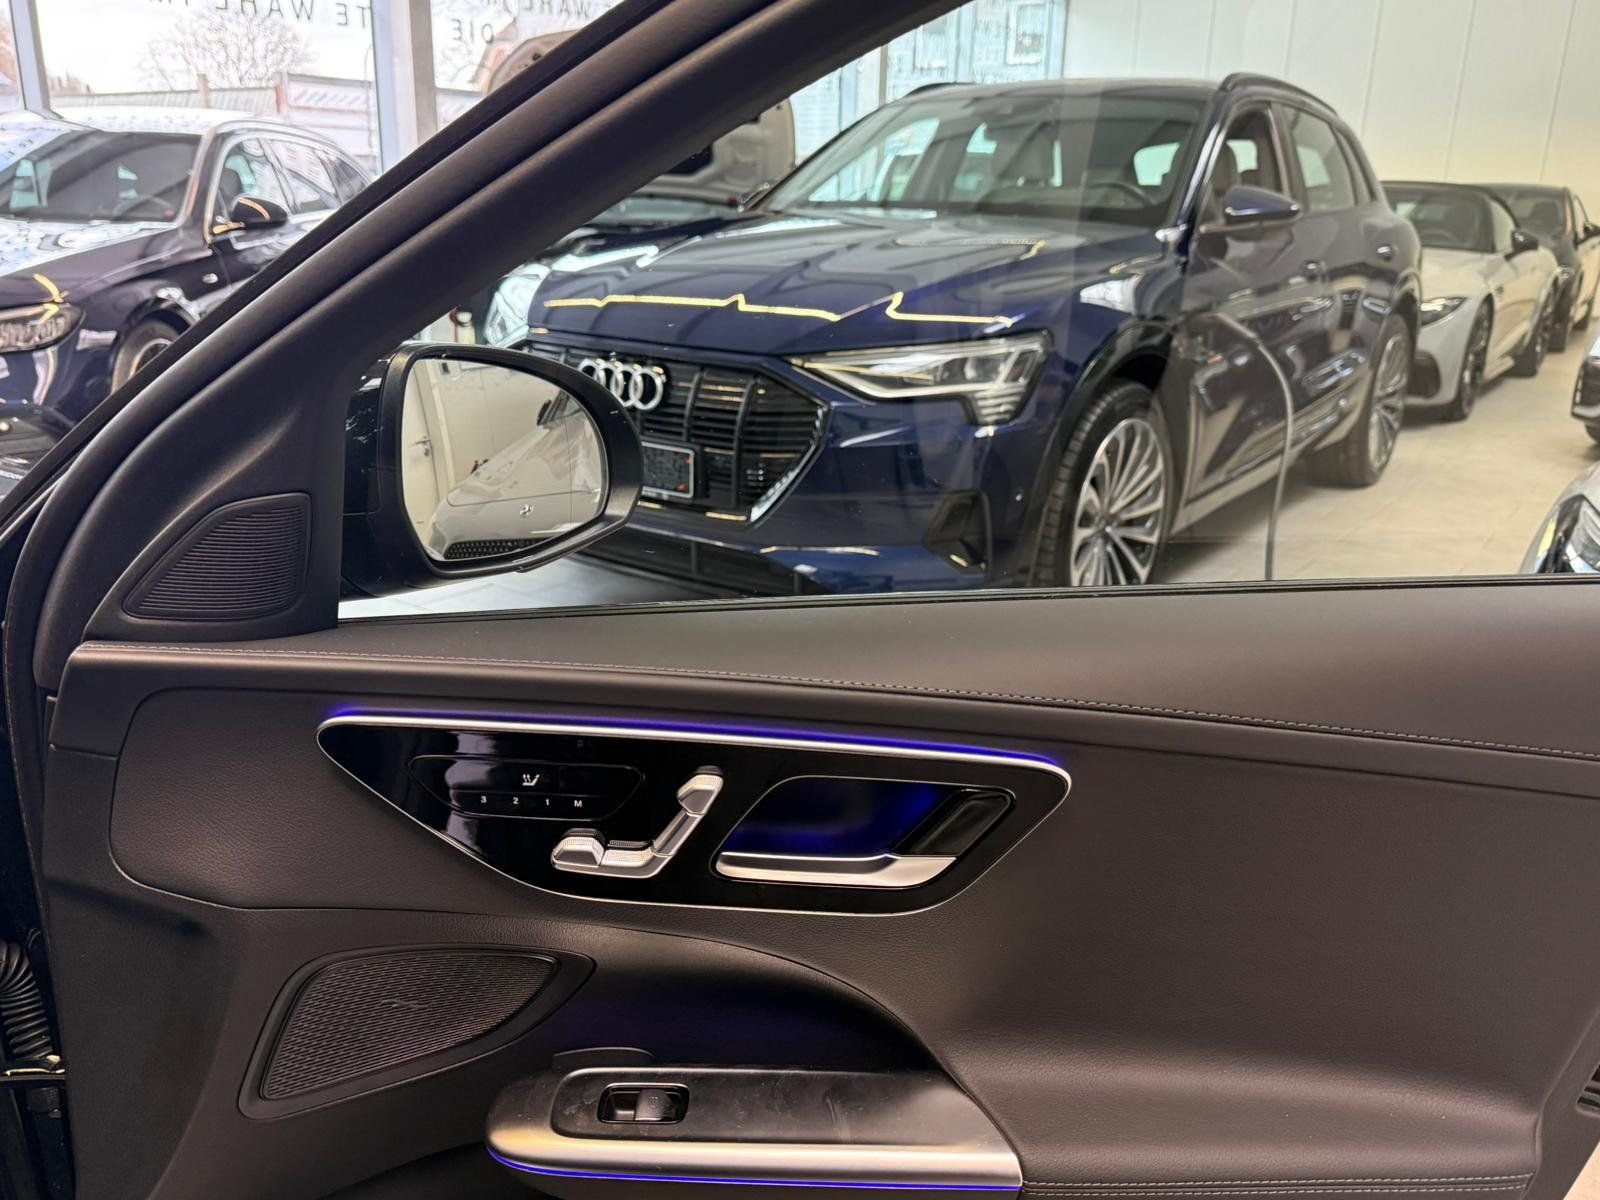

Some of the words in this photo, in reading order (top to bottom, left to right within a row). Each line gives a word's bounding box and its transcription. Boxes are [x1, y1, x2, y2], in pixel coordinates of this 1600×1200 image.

[480, 795, 487, 803] 3
[545, 798, 550, 806] 1
[573, 799, 583, 807] M
